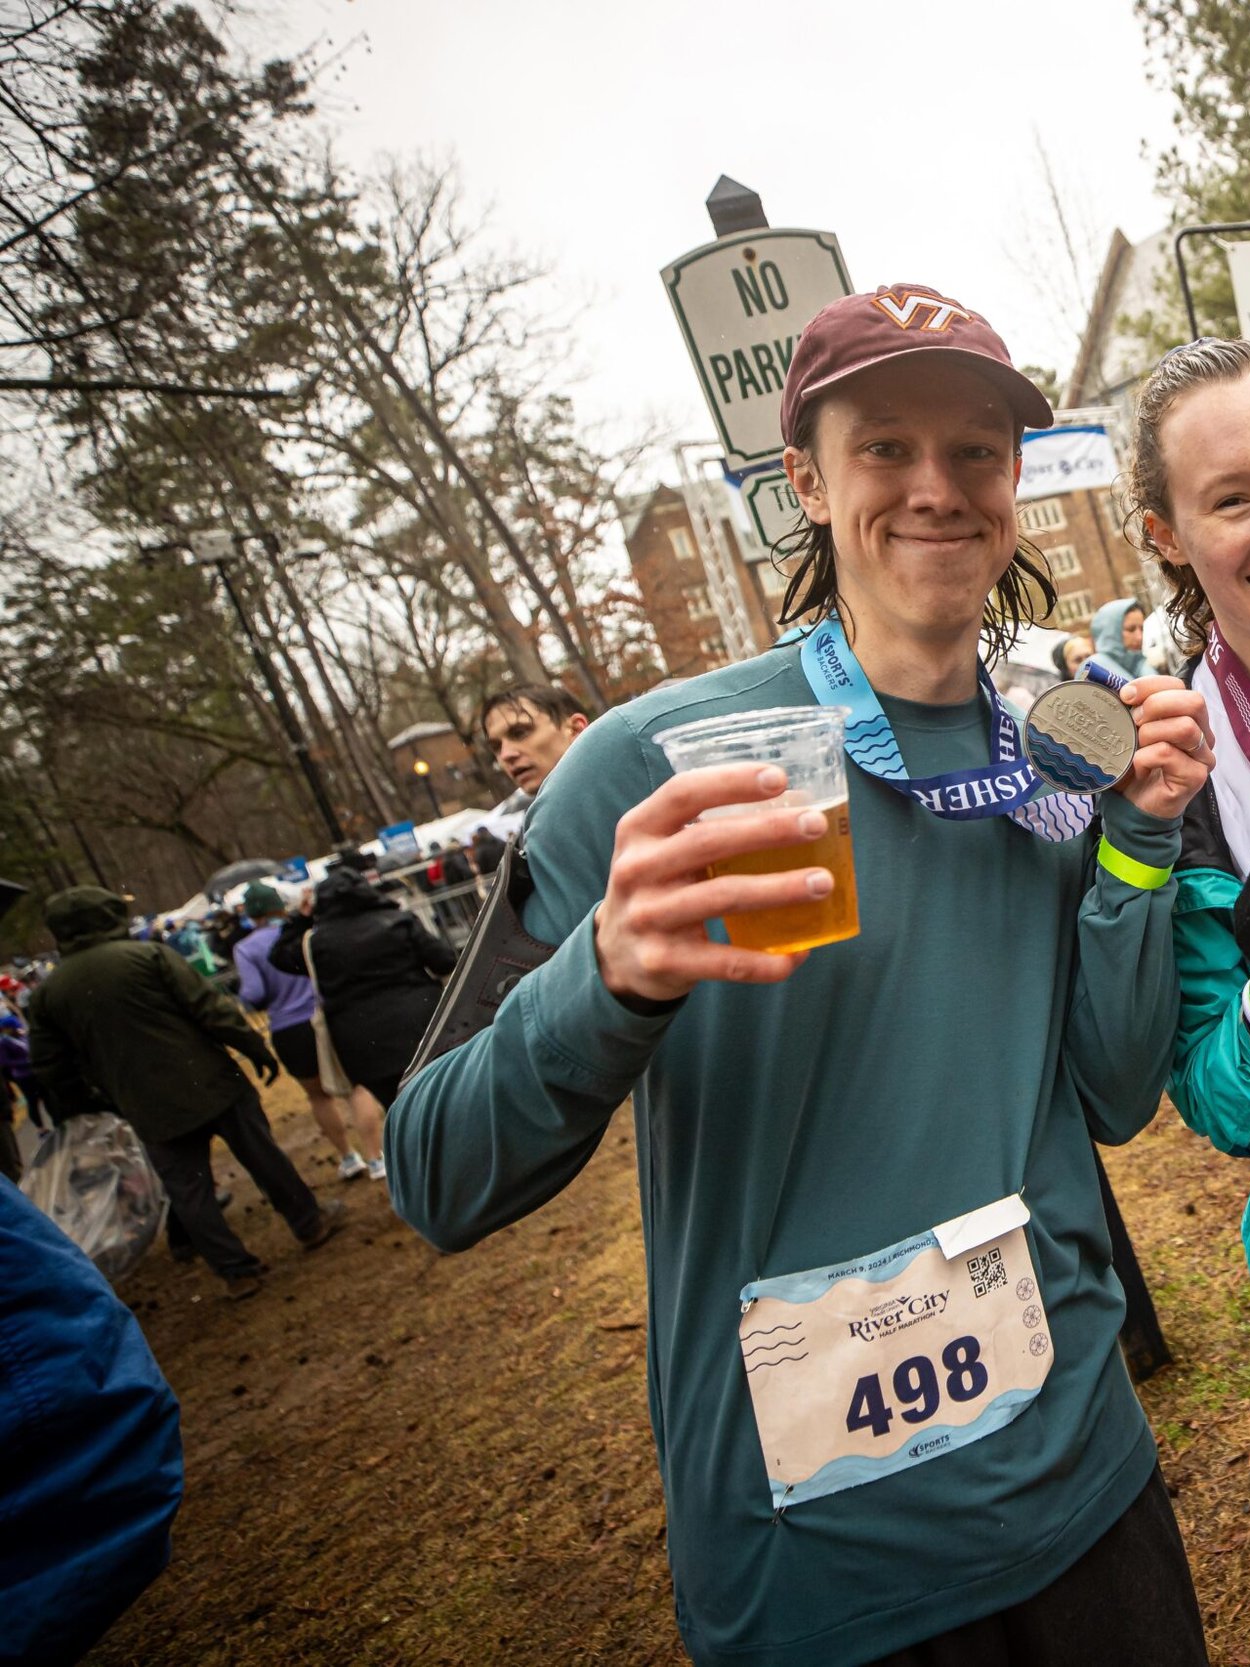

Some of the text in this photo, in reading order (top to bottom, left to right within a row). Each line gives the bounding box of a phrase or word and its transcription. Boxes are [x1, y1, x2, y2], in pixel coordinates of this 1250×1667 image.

[731, 260, 789, 317] NO
[872, 291, 972, 332] VT
[817, 656, 838, 691] BACKERS
[824, 644, 851, 687] SPORTS
[828, 1269, 858, 1280] MARCH
[868, 1258, 888, 1270] 2024
[848, 1289, 950, 1342] River City
[879, 1311, 936, 1338] HALF MARATHON
[846, 1335, 989, 1437] 498
[919, 1434, 950, 1452] SPORTS
